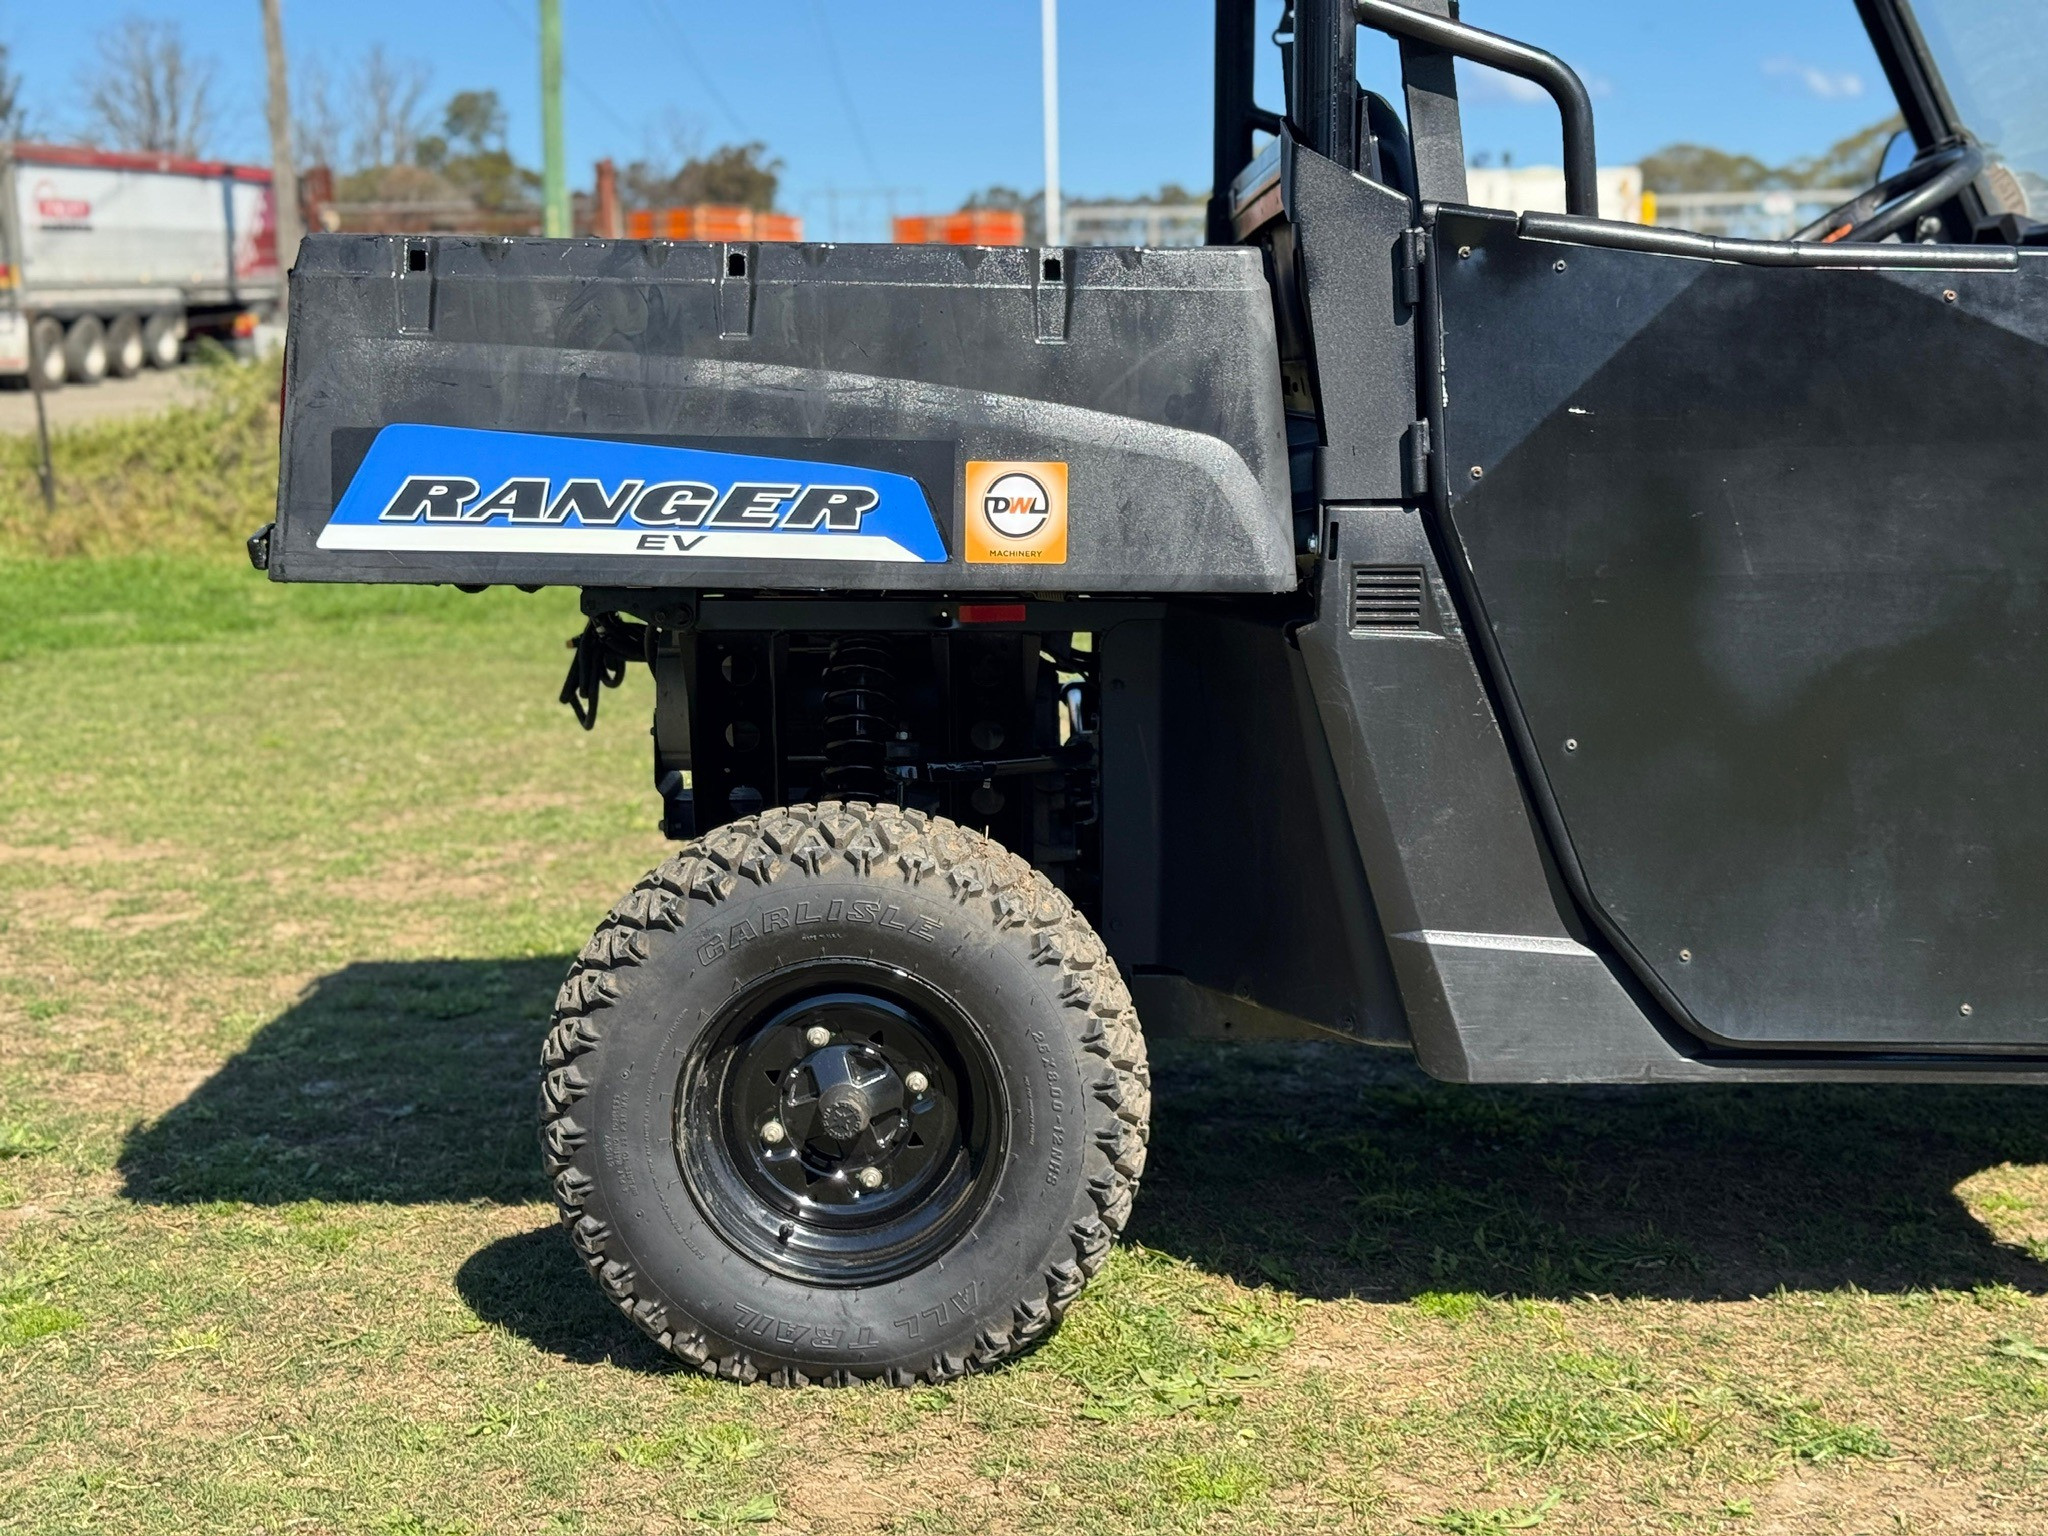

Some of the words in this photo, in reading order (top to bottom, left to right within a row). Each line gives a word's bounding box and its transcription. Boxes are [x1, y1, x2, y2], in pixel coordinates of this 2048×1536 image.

[378, 475, 880, 531] RANGER
[984, 496, 1049, 514] DWL
[636, 535, 708, 551] EV
[989, 550, 1043, 558] MACHINERY
[697, 898, 944, 966] CARLISLE
[734, 1302, 879, 1349] TRAIL
[894, 1281, 979, 1338] ALL
